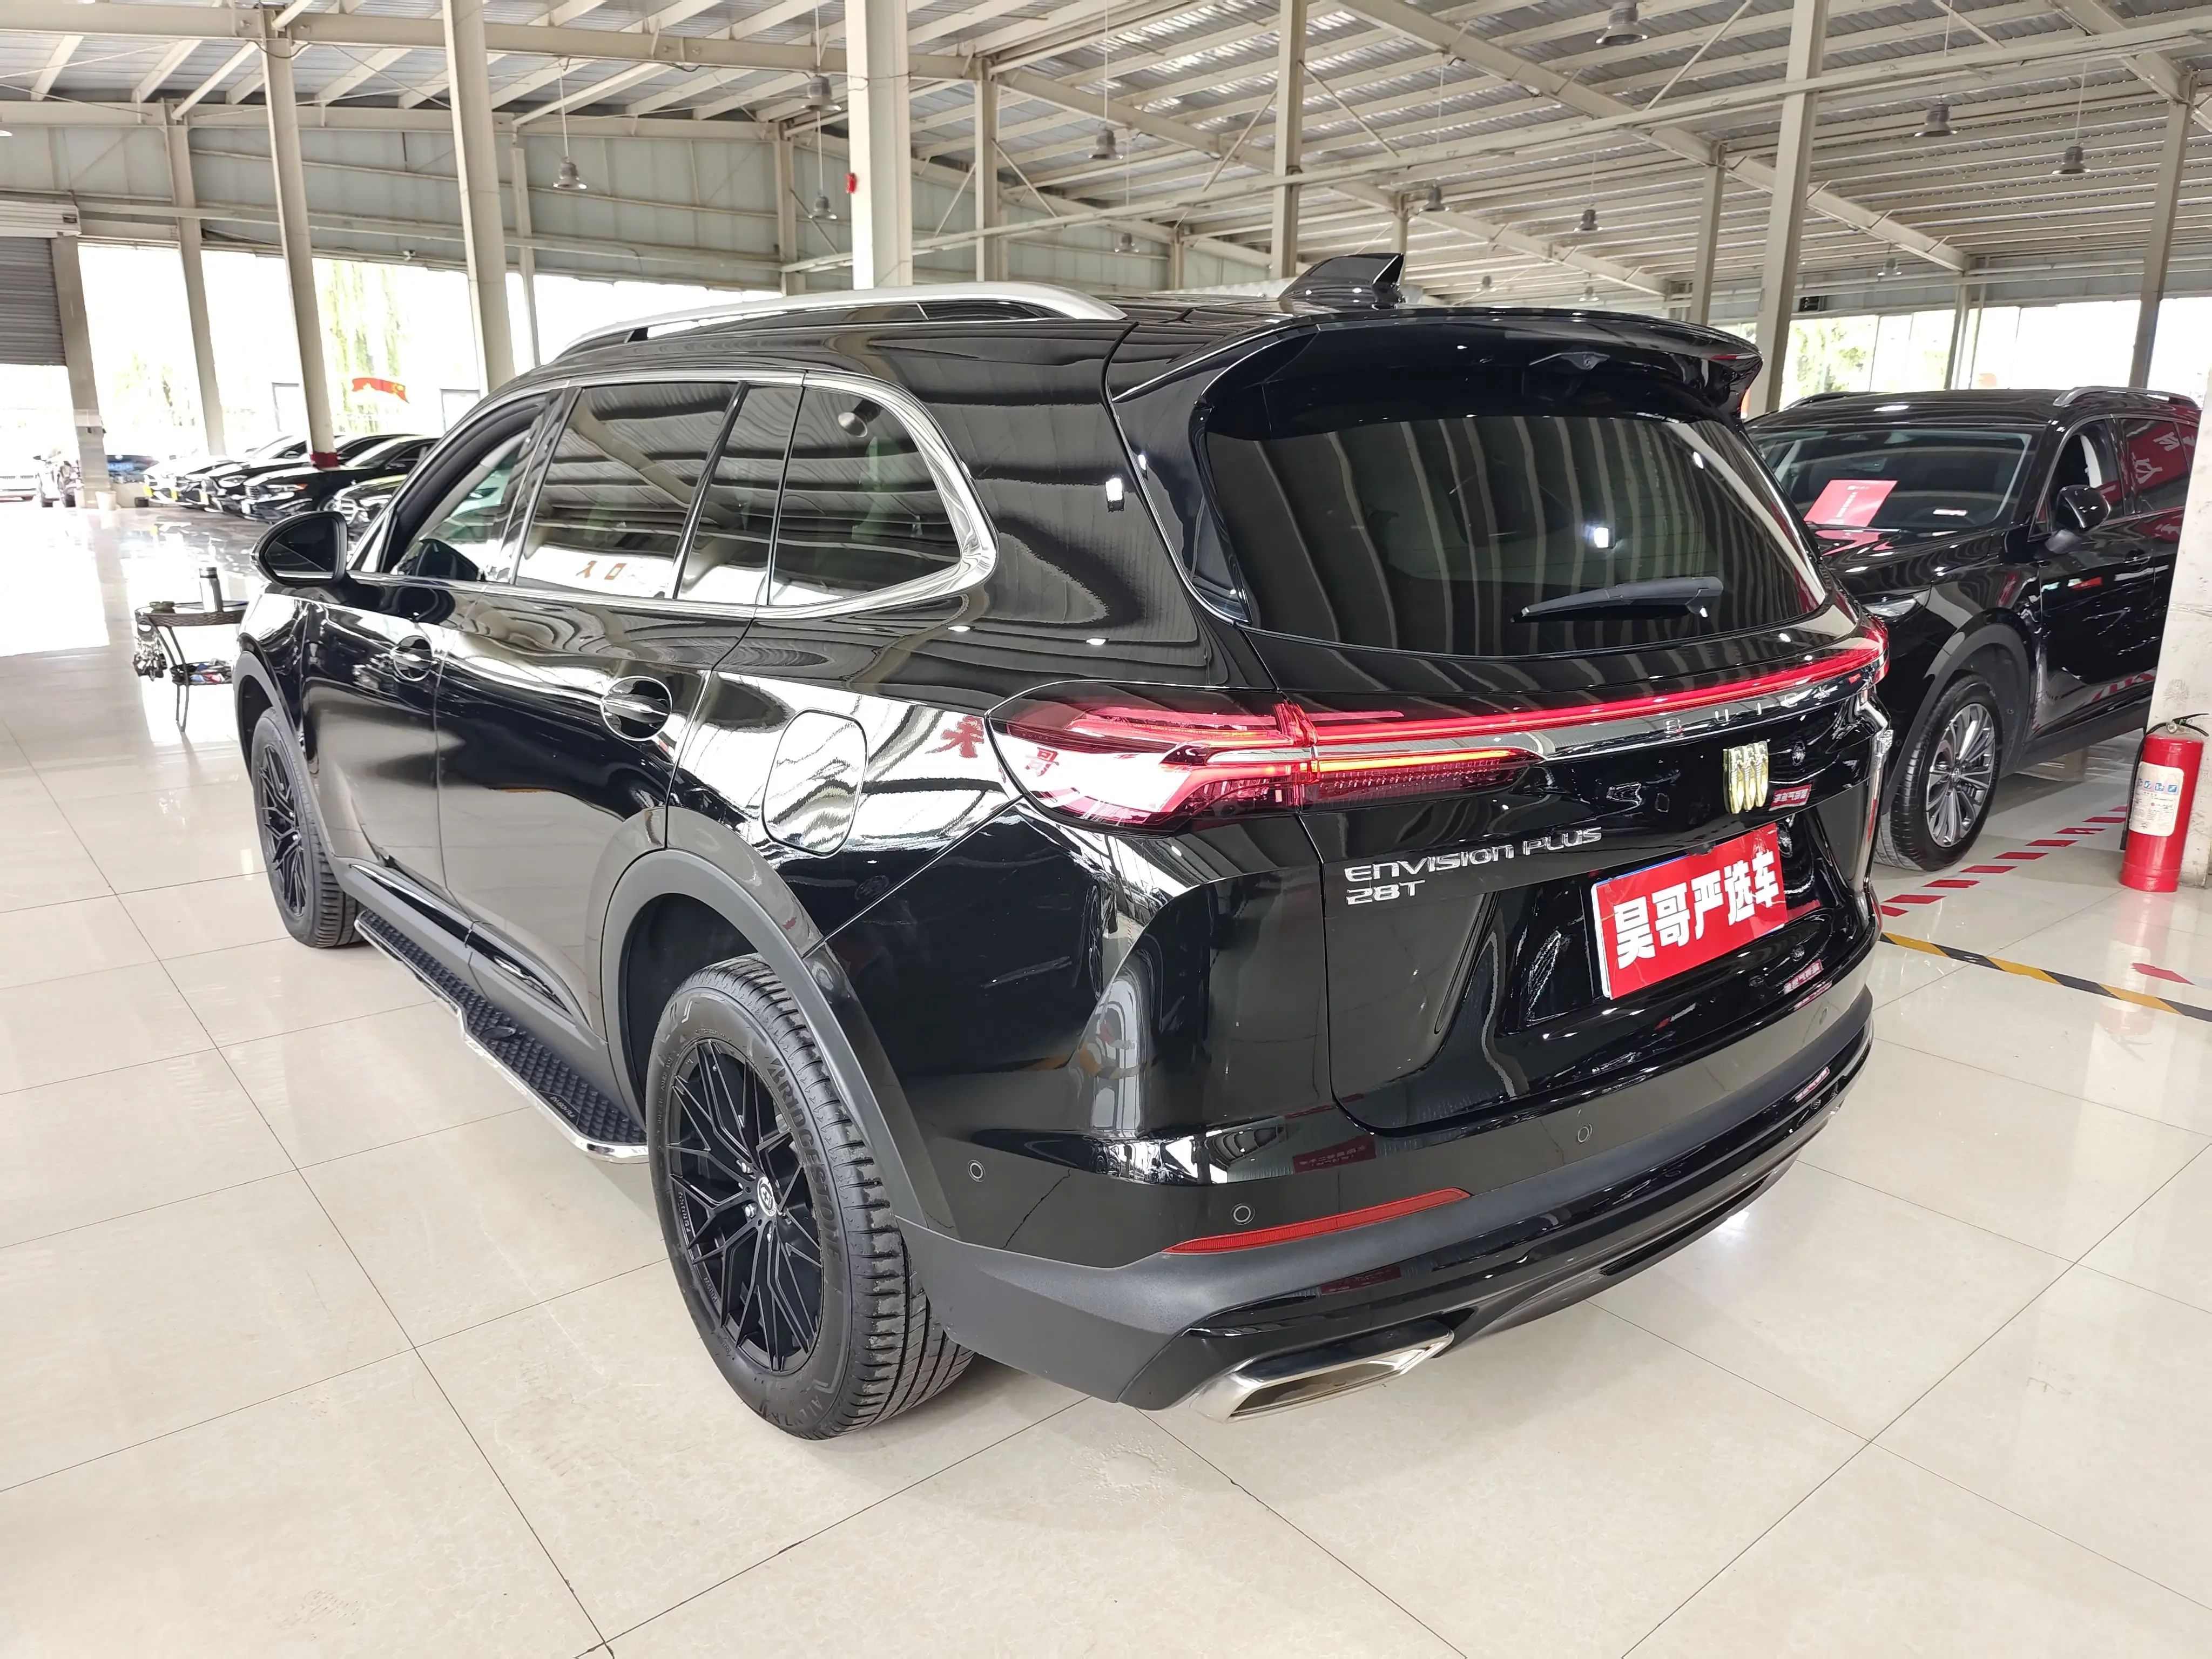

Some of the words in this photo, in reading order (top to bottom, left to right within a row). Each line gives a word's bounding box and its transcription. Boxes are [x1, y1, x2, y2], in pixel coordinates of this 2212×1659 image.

[1664, 684, 1831, 734] BUICK
[1344, 843, 1514, 883] ENVISION
[1522, 826, 1602, 856] PLUS
[1345, 879, 1426, 906] 28T
[1613, 849, 1780, 970] 昊哥严选车
[766, 1057, 843, 1266] BRIDGESTONE
